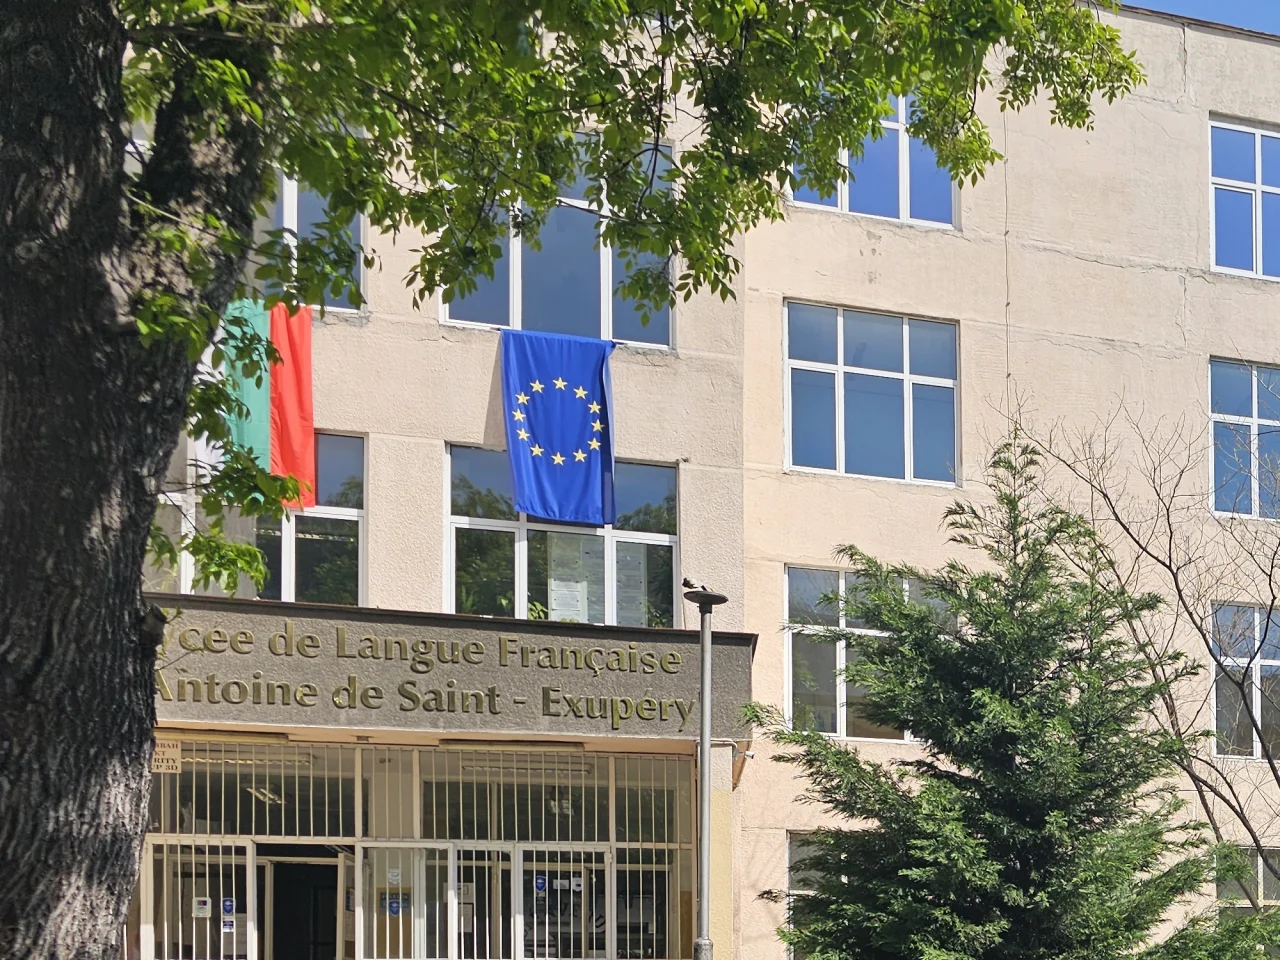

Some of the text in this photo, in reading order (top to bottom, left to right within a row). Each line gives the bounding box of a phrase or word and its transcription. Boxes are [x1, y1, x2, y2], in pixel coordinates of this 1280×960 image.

[163, 620, 682, 678] cée de Langue Française
[332, 673, 385, 710] de
[397, 678, 501, 715] Saint
[513, 696, 526, 705] -
[541, 685, 697, 733] Exupéry
